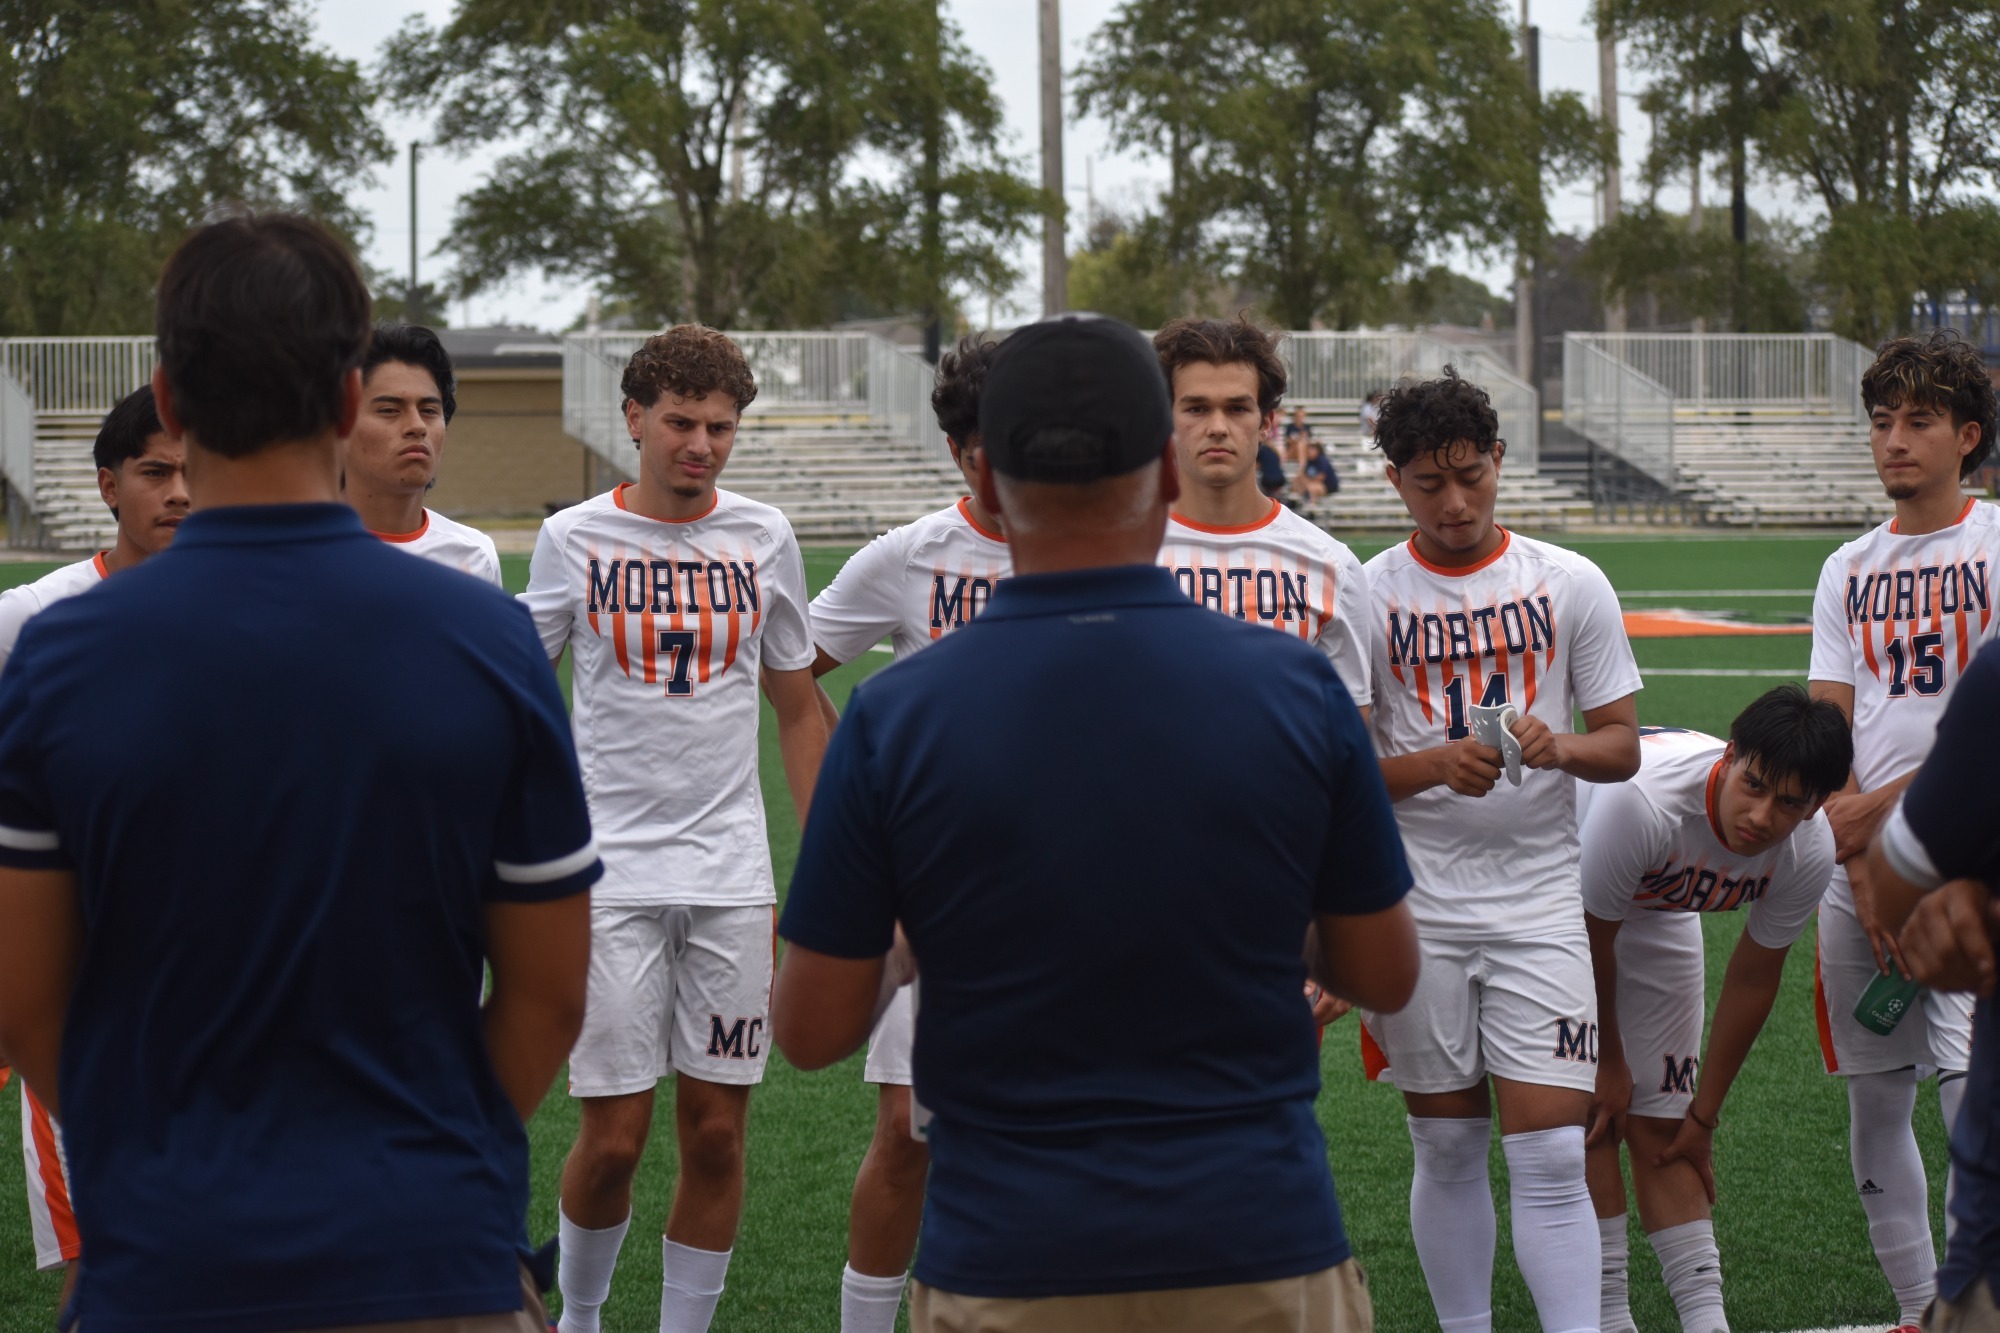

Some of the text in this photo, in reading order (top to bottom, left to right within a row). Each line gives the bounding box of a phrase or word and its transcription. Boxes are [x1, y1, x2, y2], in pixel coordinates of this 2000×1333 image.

[587, 558, 759, 614] MORTON
[1162, 566, 1308, 621] ORTON
[1846, 560, 1988, 625] MORTON
[1387, 594, 1554, 667] MORTON
[657, 630, 697, 697] 7
[1885, 631, 1946, 698] 15
[706, 1014, 763, 1060] MC
